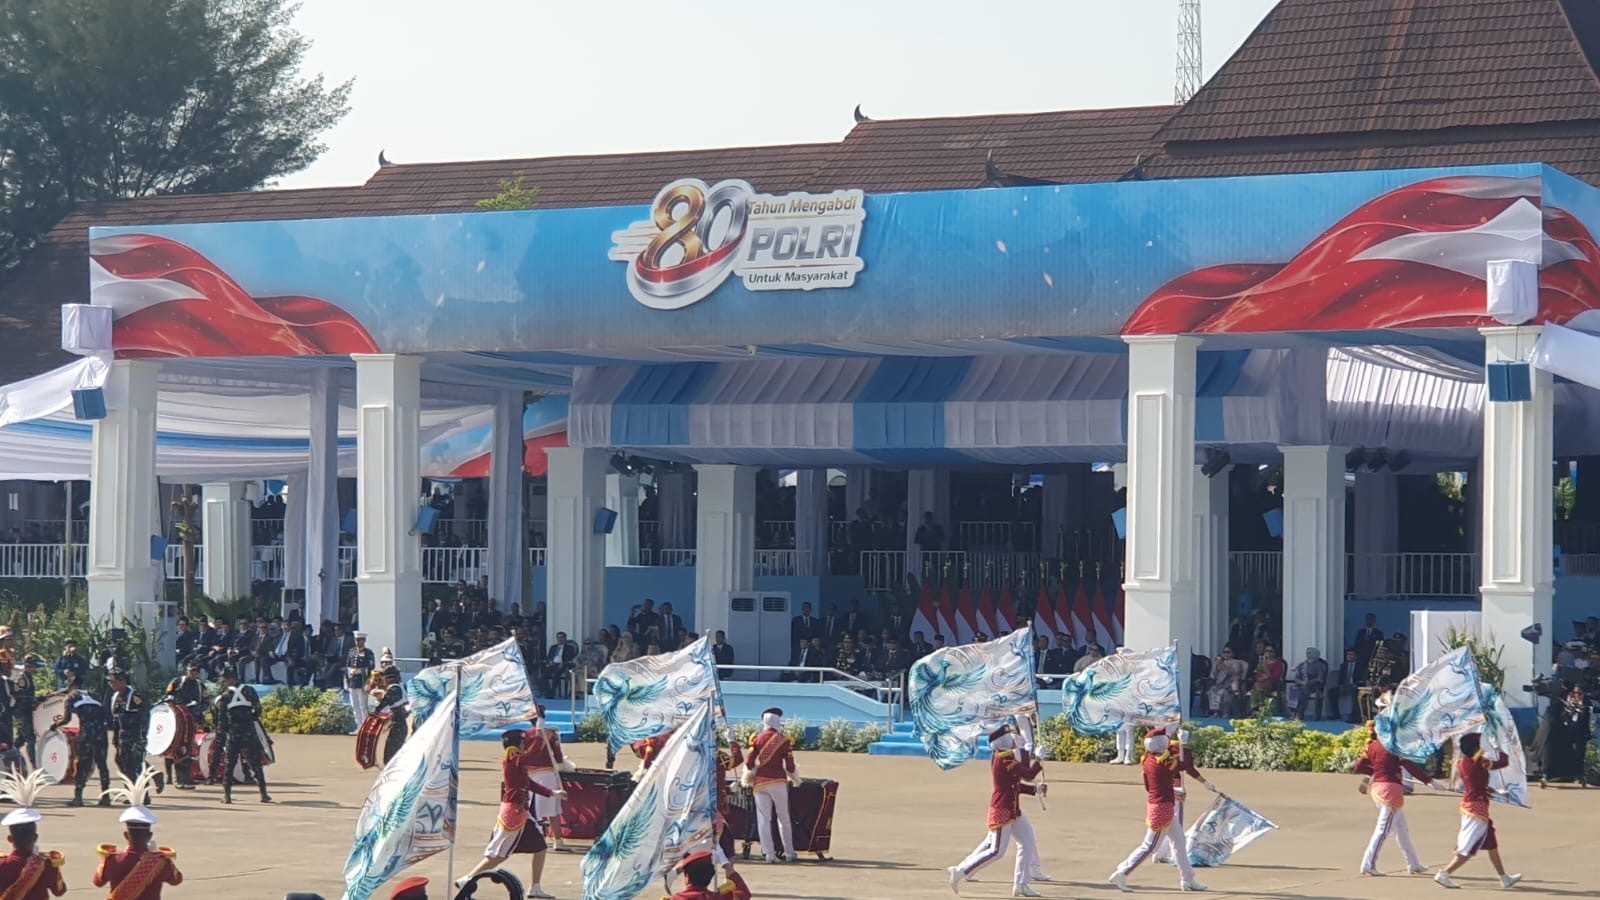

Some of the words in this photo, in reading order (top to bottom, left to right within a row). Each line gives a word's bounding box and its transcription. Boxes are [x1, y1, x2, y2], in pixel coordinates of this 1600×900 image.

[748, 200, 786, 215] Tahun
[788, 196, 857, 215] Mengabdi
[642, 185, 749, 271] 80
[747, 224, 855, 262] POLRI
[748, 273, 782, 283] Untuk
[784, 270, 848, 283] Masyarakat
